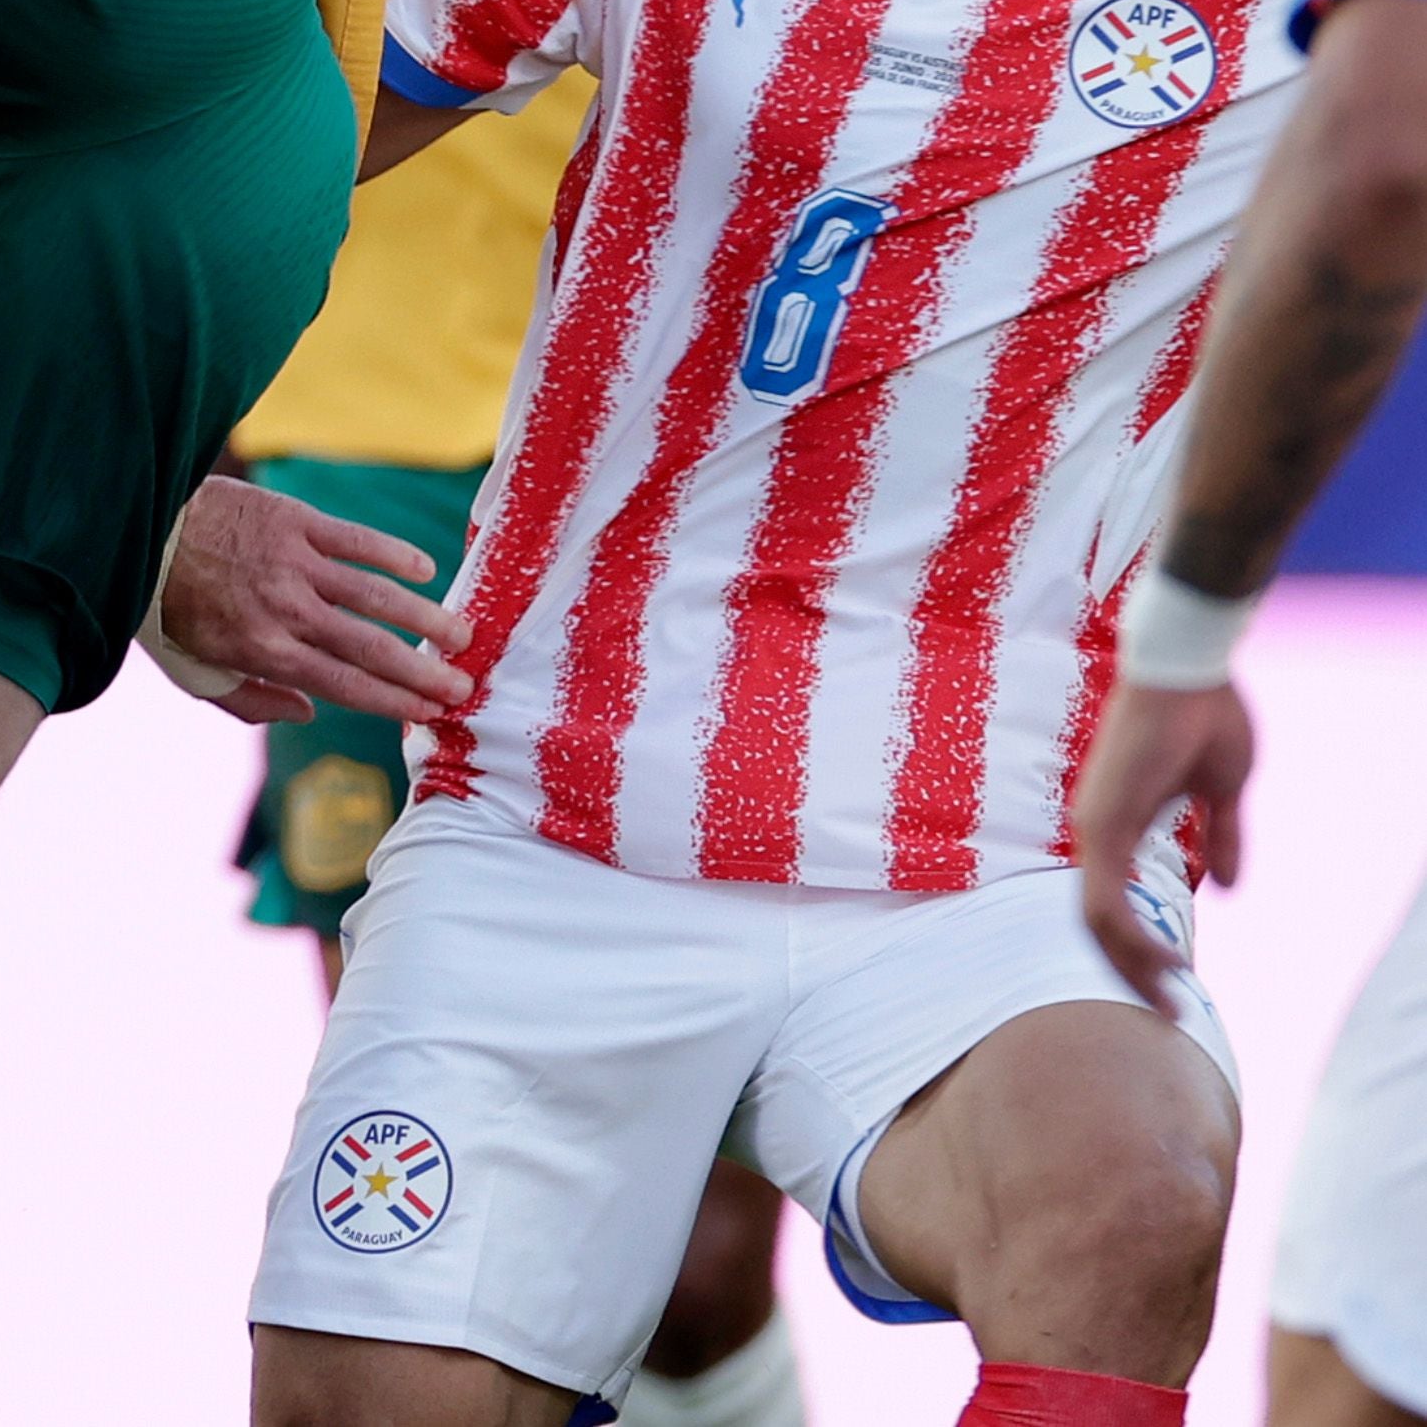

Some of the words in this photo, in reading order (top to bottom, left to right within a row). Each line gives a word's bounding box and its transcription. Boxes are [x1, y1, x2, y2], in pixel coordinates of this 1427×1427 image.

[1126, 3, 1178, 29] APF
[1100, 99, 1166, 122] PARAGUAY
[739, 187, 901, 407] 8
[363, 1122, 411, 1146] APF
[340, 1225, 404, 1246] PARAGUAY
